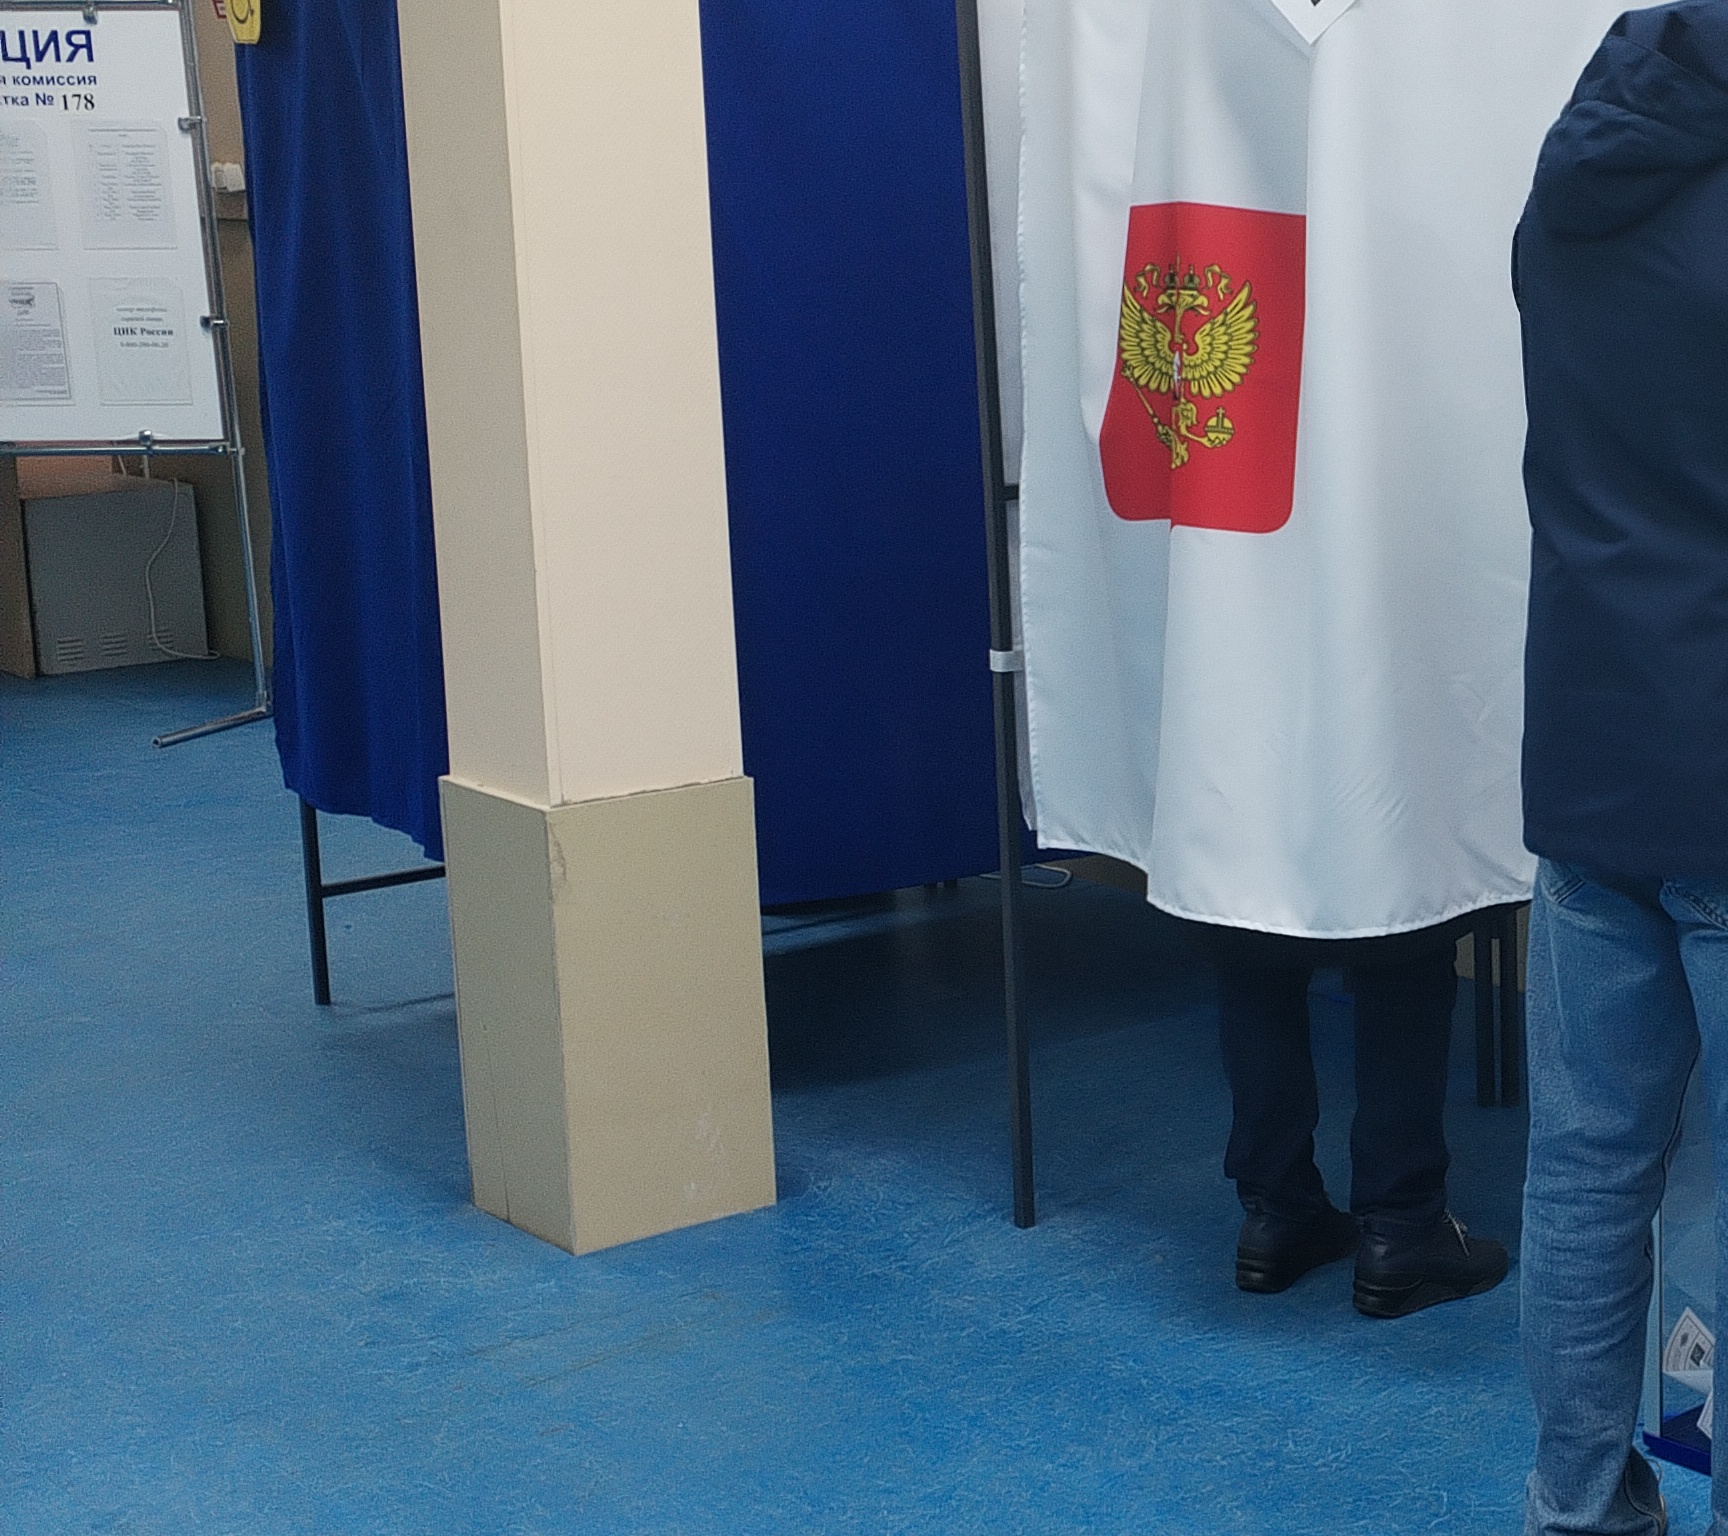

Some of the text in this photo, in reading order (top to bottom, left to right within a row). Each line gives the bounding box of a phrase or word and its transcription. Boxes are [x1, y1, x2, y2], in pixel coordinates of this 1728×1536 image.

[12, 75, 97, 86] комиссия
[0, 92, 95, 111] тка № 178
[113, 327, 138, 336] ЦИК
